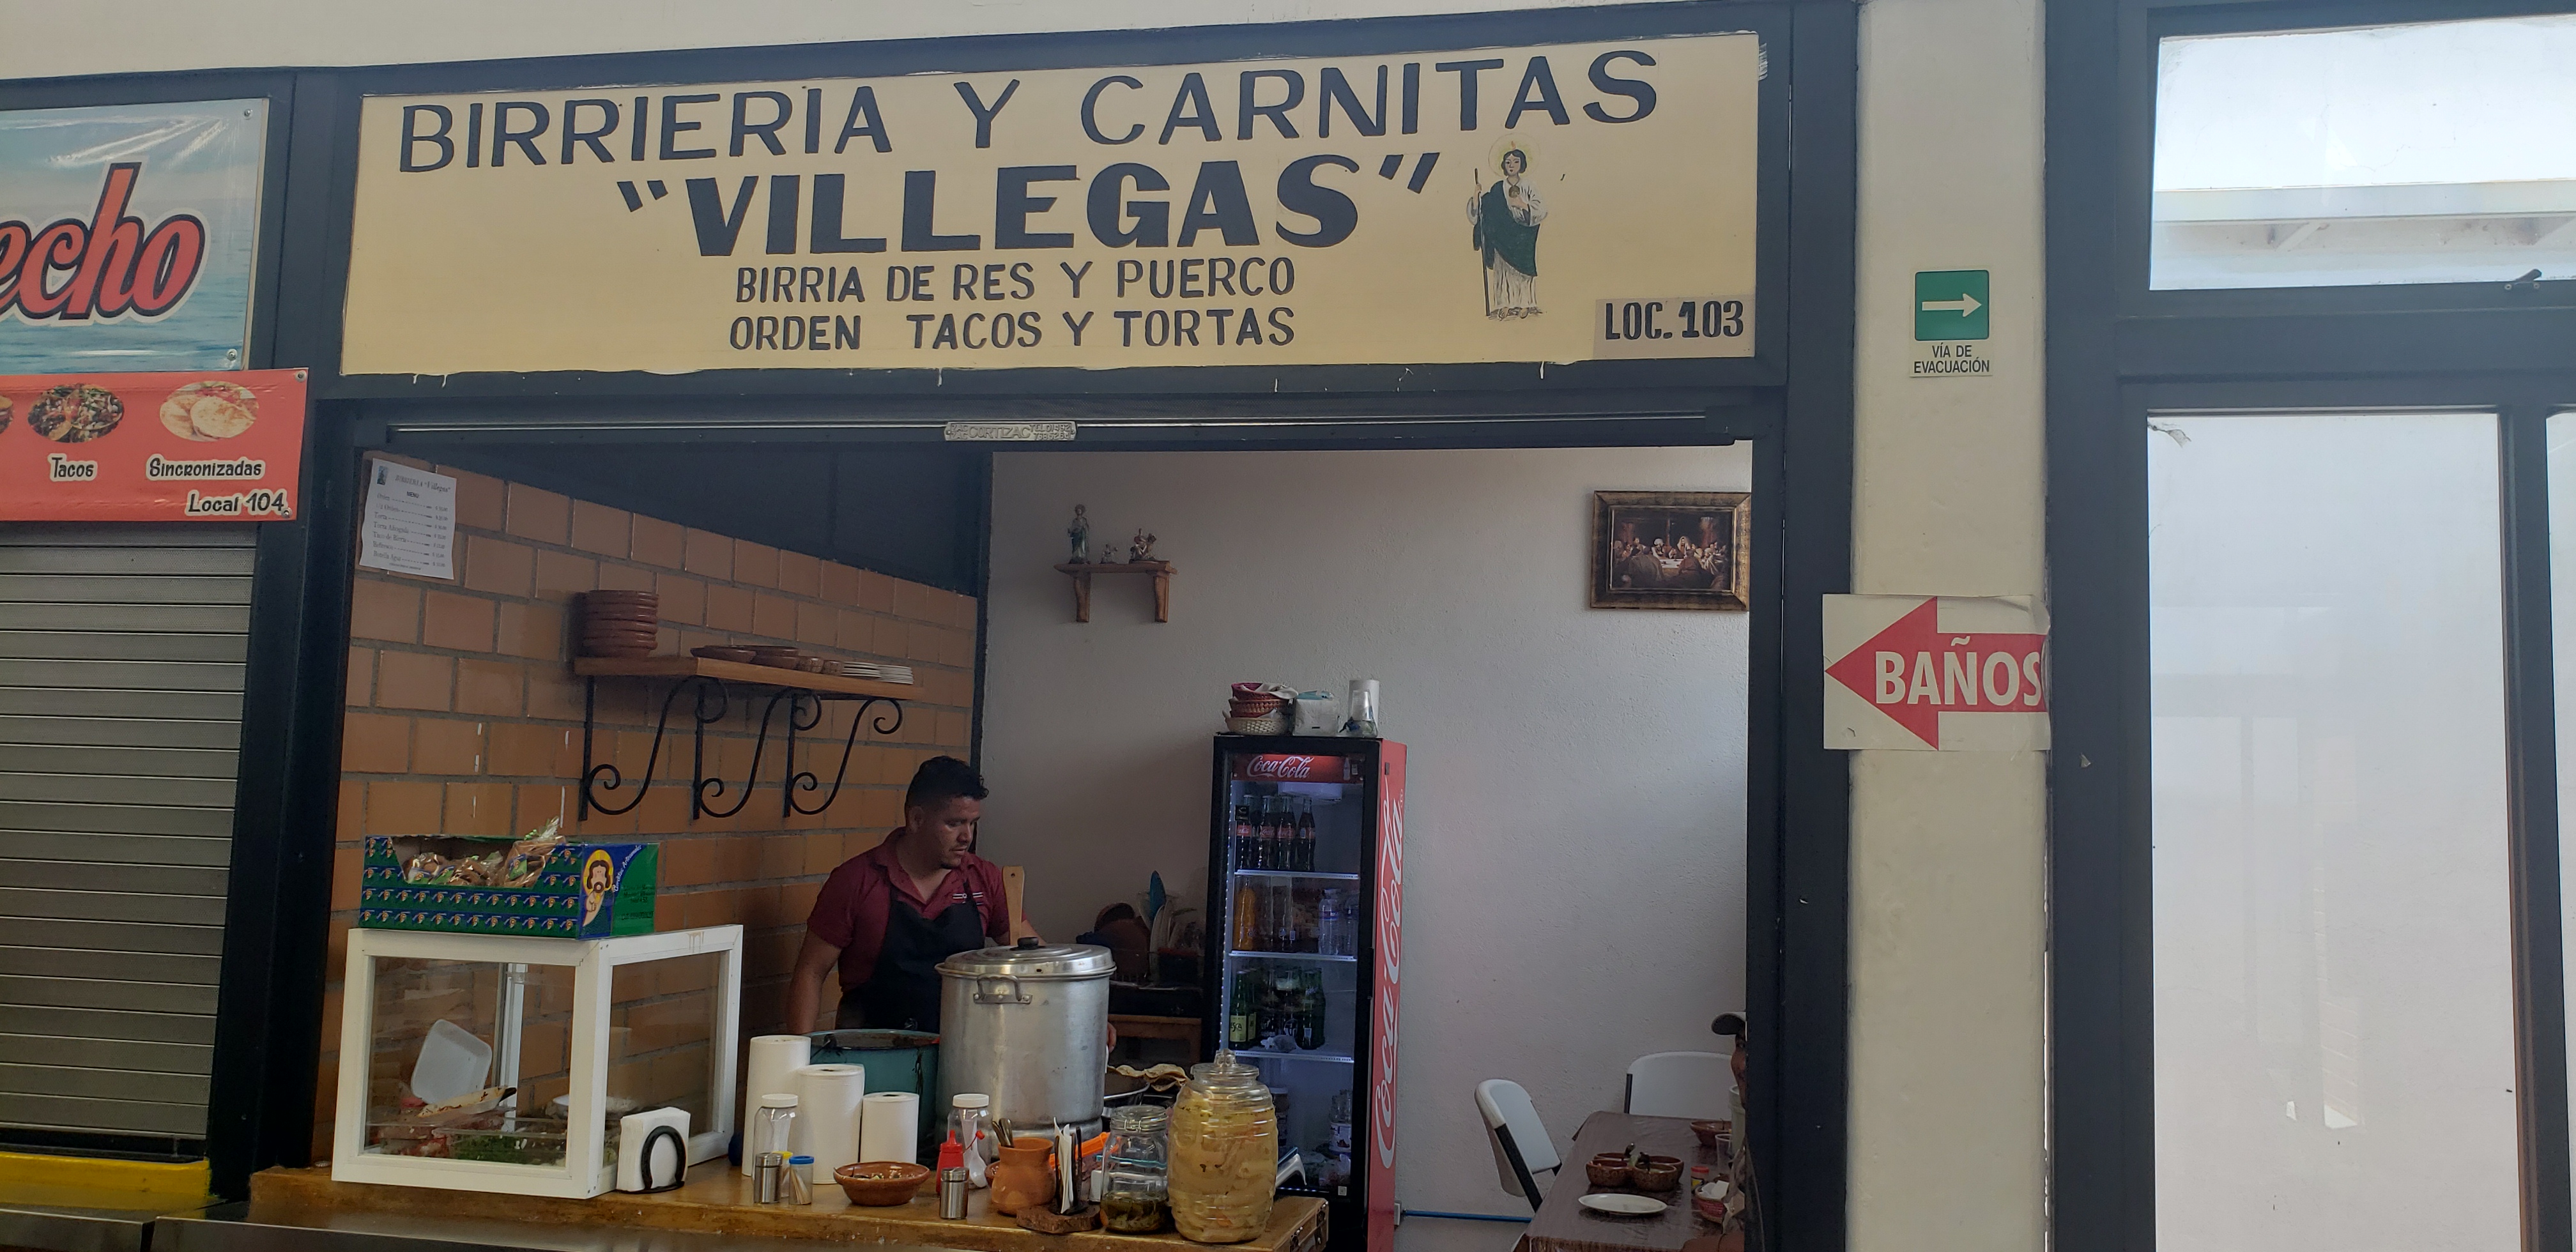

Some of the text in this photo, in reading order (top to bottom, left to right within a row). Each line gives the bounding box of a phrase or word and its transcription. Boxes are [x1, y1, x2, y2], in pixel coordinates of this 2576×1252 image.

[400, 50, 1657, 172] BIRRIERIA Y CARNITAS
[736, 257, 1295, 303] BIRRIA DE RES Y PUERCO
[730, 307, 1294, 351] ORDEN TACOS Y TORTAS
[1605, 300, 1744, 340] LOC. 103
[1931, 342, 1972, 358] VÍA DE
[1914, 356, 1989, 373] EVACUACIÓN
[969, 426, 1031, 439] CORTIZAC
[51, 457, 94, 478] Tacos
[150, 458, 262, 477] Sincronizadas
[188, 492, 284, 512] Local 104
[1875, 636, 2042, 706] BAÑOS
[1246, 755, 1315, 779] Coca-Cola
